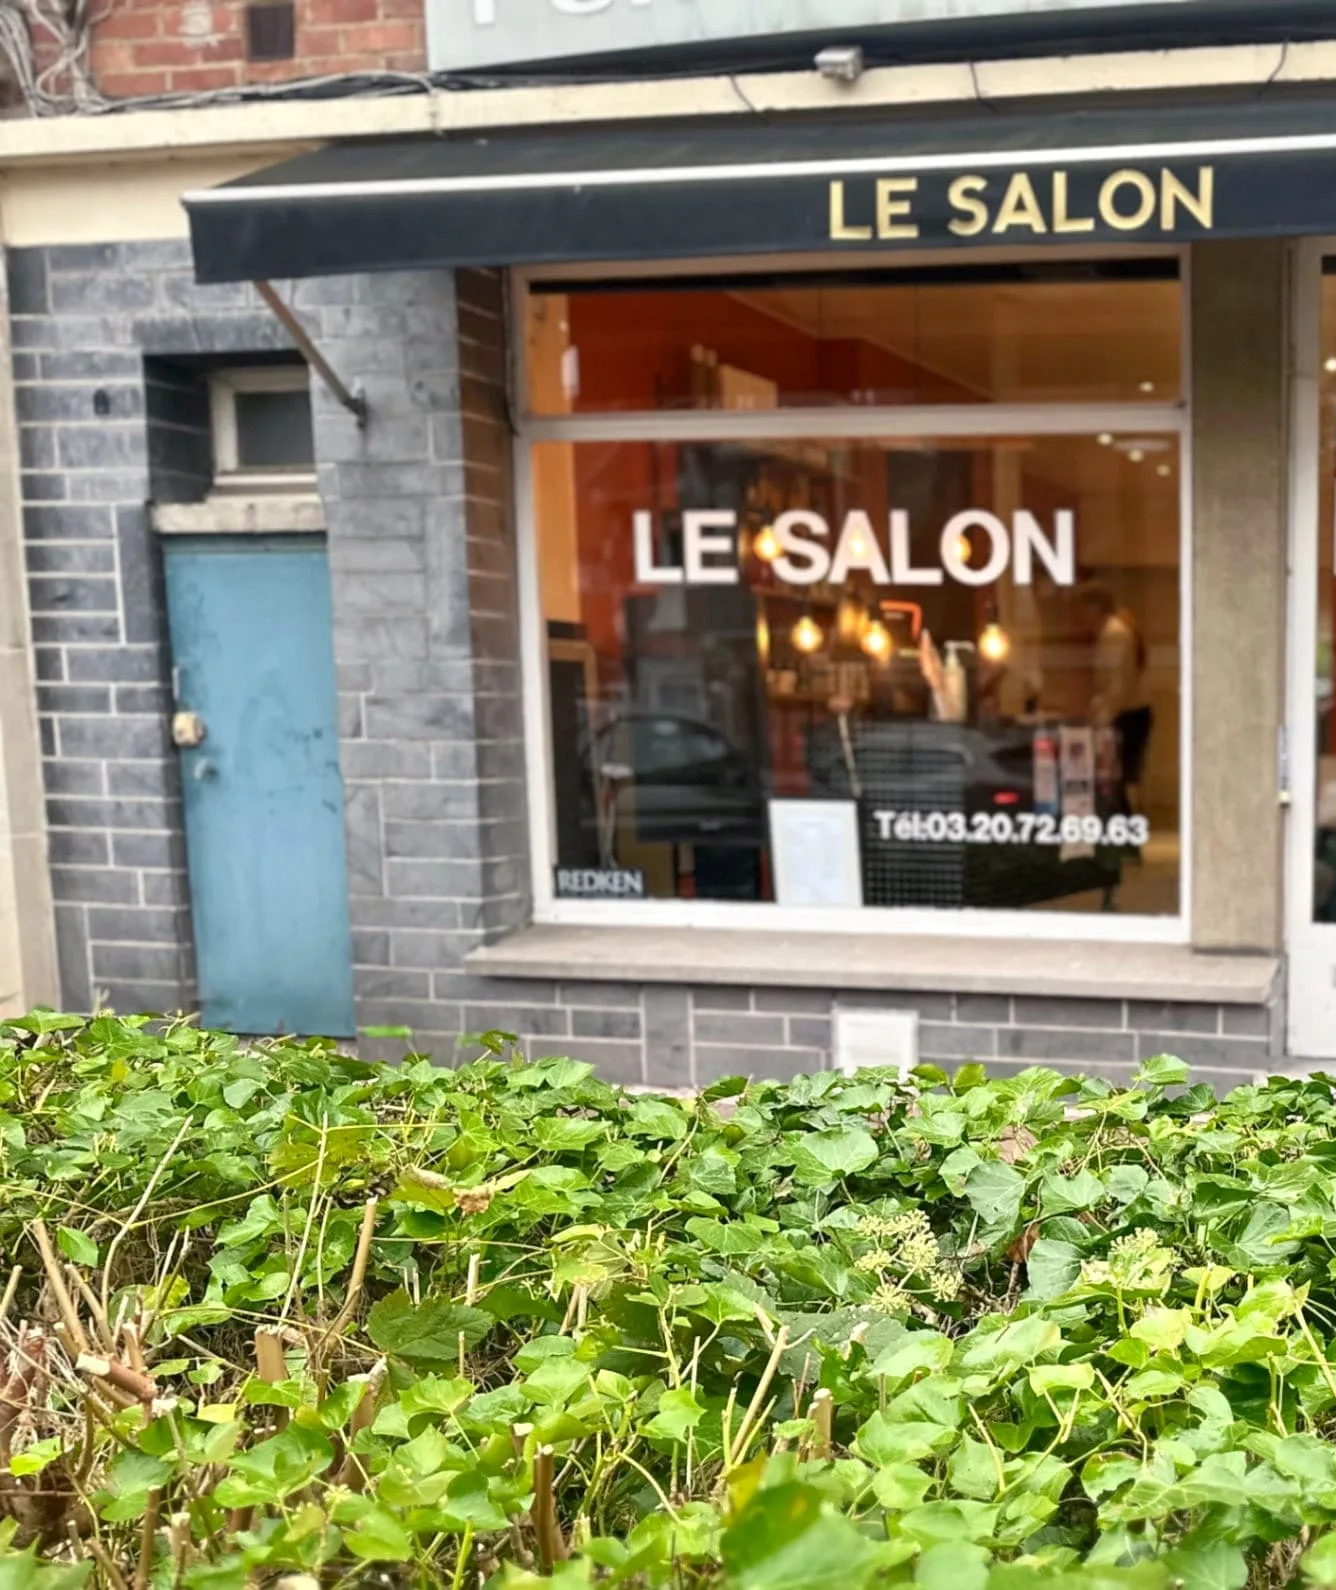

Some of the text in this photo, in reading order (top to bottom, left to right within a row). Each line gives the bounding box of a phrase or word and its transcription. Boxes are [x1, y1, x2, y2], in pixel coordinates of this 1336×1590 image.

[828, 166, 1214, 241] LE SALON
[632, 508, 1076, 586] LE SALON
[557, 867, 644, 894] REDKEN
